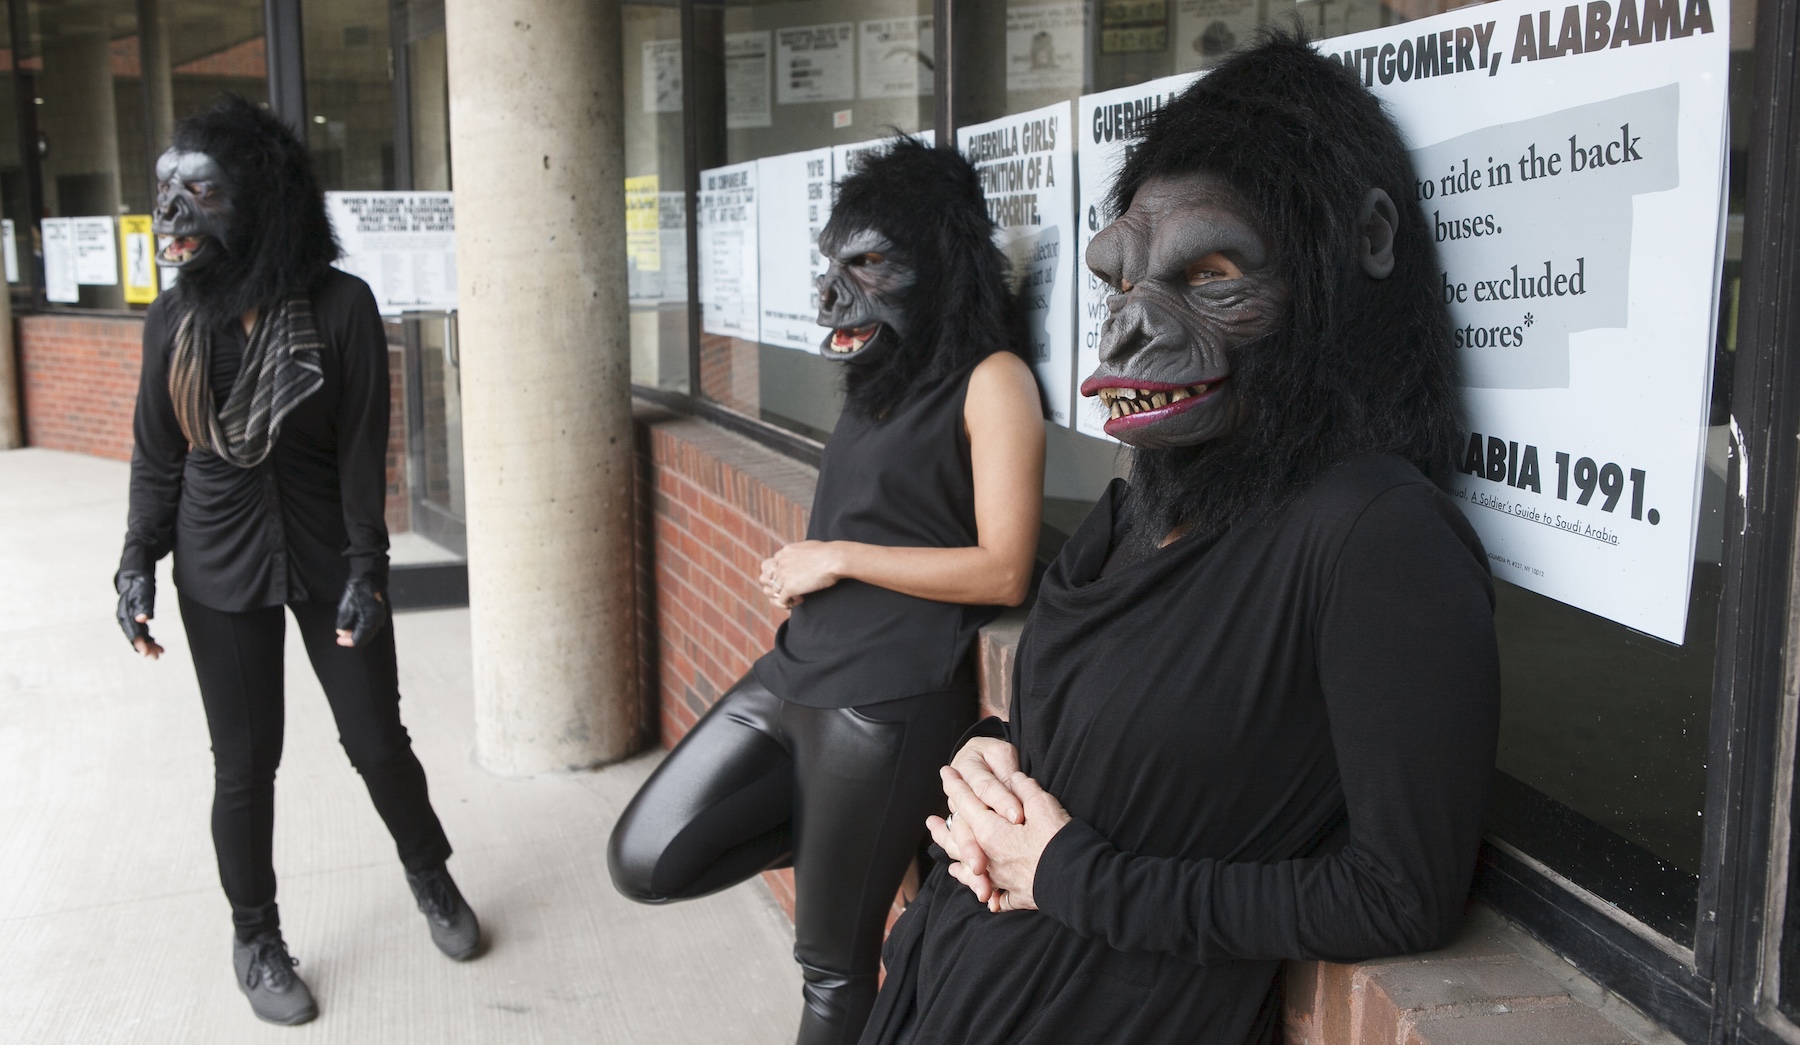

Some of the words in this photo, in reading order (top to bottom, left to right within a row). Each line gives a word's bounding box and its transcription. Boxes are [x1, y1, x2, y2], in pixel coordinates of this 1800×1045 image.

[1329, 21, 1502, 87] NTGOMERY,
[1511, 0, 1715, 64] ALABAMA
[969, 126, 1018, 162] GUERRILLA
[1023, 116, 1058, 155] GIRLS'
[1416, 176, 1435, 200] to
[1440, 158, 1482, 197] ride
[1487, 156, 1512, 188] in
[1518, 143, 1562, 181] the
[1568, 123, 1643, 173] back
[1027, 157, 1042, 190] OF
[1046, 155, 1055, 188] A
[986, 194, 1041, 228] YPOCRITE.
[1433, 210, 1502, 243] buses.
[1441, 271, 1468, 305] be
[1474, 257, 1587, 302] excluded
[1087, 323, 1099, 349] of
[1461, 432, 1541, 494] ABIA
[1555, 451, 1661, 526] 1991.
[1471, 491, 1477, 501] A
[1480, 492, 1512, 513] Soldier's
[1515, 503, 1540, 521] Guide
[1543, 512, 1553, 525] to
[1556, 514, 1583, 533] Saudi
[1585, 523, 1621, 546] Arabia.
